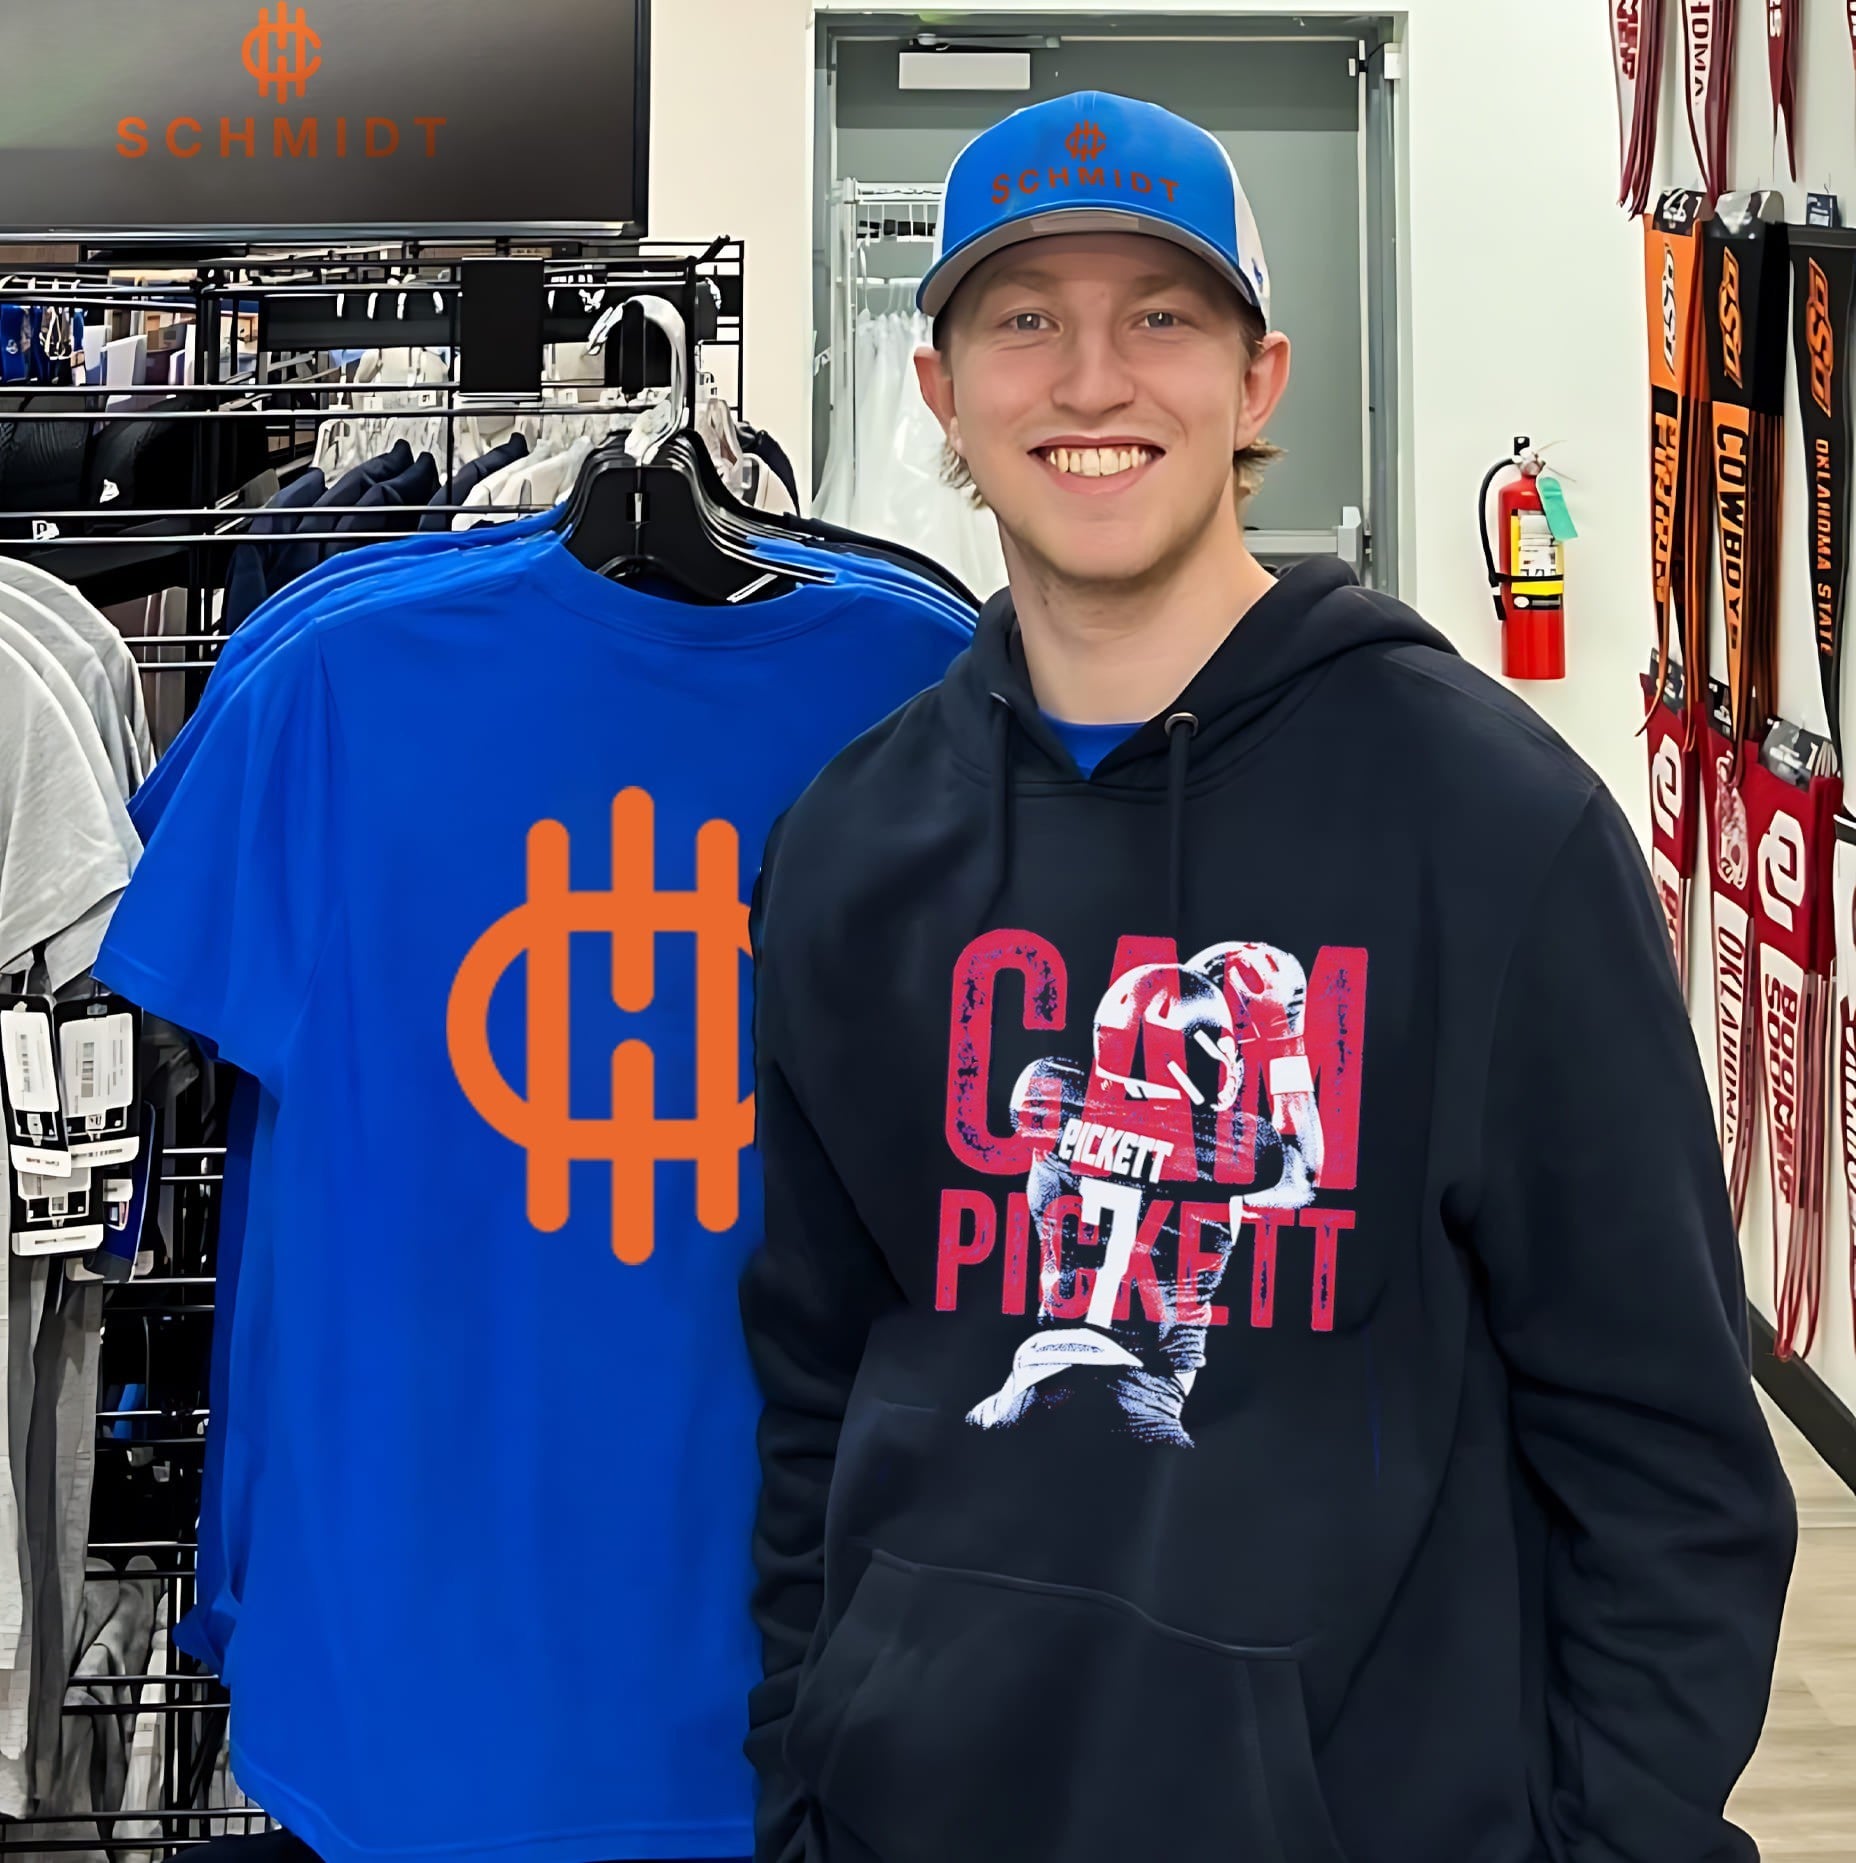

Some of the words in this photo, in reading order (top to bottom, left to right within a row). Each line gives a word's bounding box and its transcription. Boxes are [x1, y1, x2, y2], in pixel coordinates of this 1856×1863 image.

[115, 116, 448, 159] SCHMIDT
[991, 166, 1180, 205] SCHMIDT
[1815, 438, 1832, 570] OKLAHOMA
[1816, 583, 1834, 657] STATE
[945, 928, 1369, 1190] CAM
[1718, 926, 1745, 1144] OKLAHOMA
[1059, 1118, 1174, 1184] PICKETT
[934, 1188, 1356, 1332] PICKETT
[1080, 1177, 1142, 1329] 7
